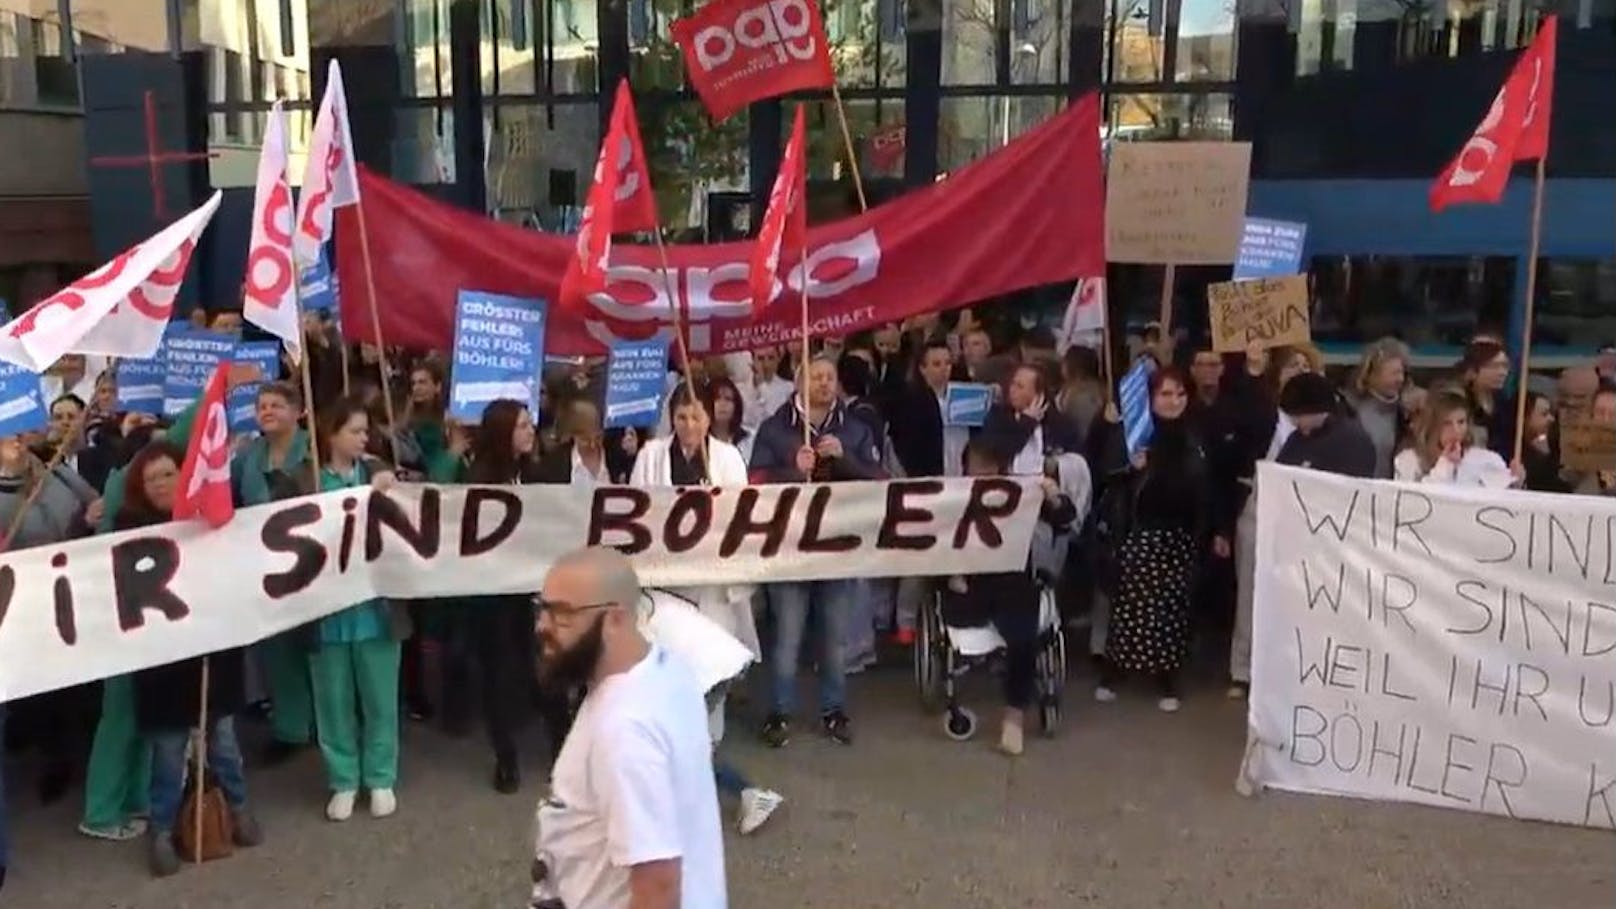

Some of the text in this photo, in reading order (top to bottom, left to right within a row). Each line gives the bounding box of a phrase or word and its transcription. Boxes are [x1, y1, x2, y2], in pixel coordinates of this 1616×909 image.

[458, 335, 532, 355] AUS FÜRS
[587, 479, 1023, 560] BÖHLER
[1292, 480, 1432, 556] WIR
[1301, 559, 1417, 634] WIR
[1295, 626, 1418, 701] WEIL
[1448, 654, 1548, 722] IHR
[1289, 700, 1516, 819] BÖHLER
